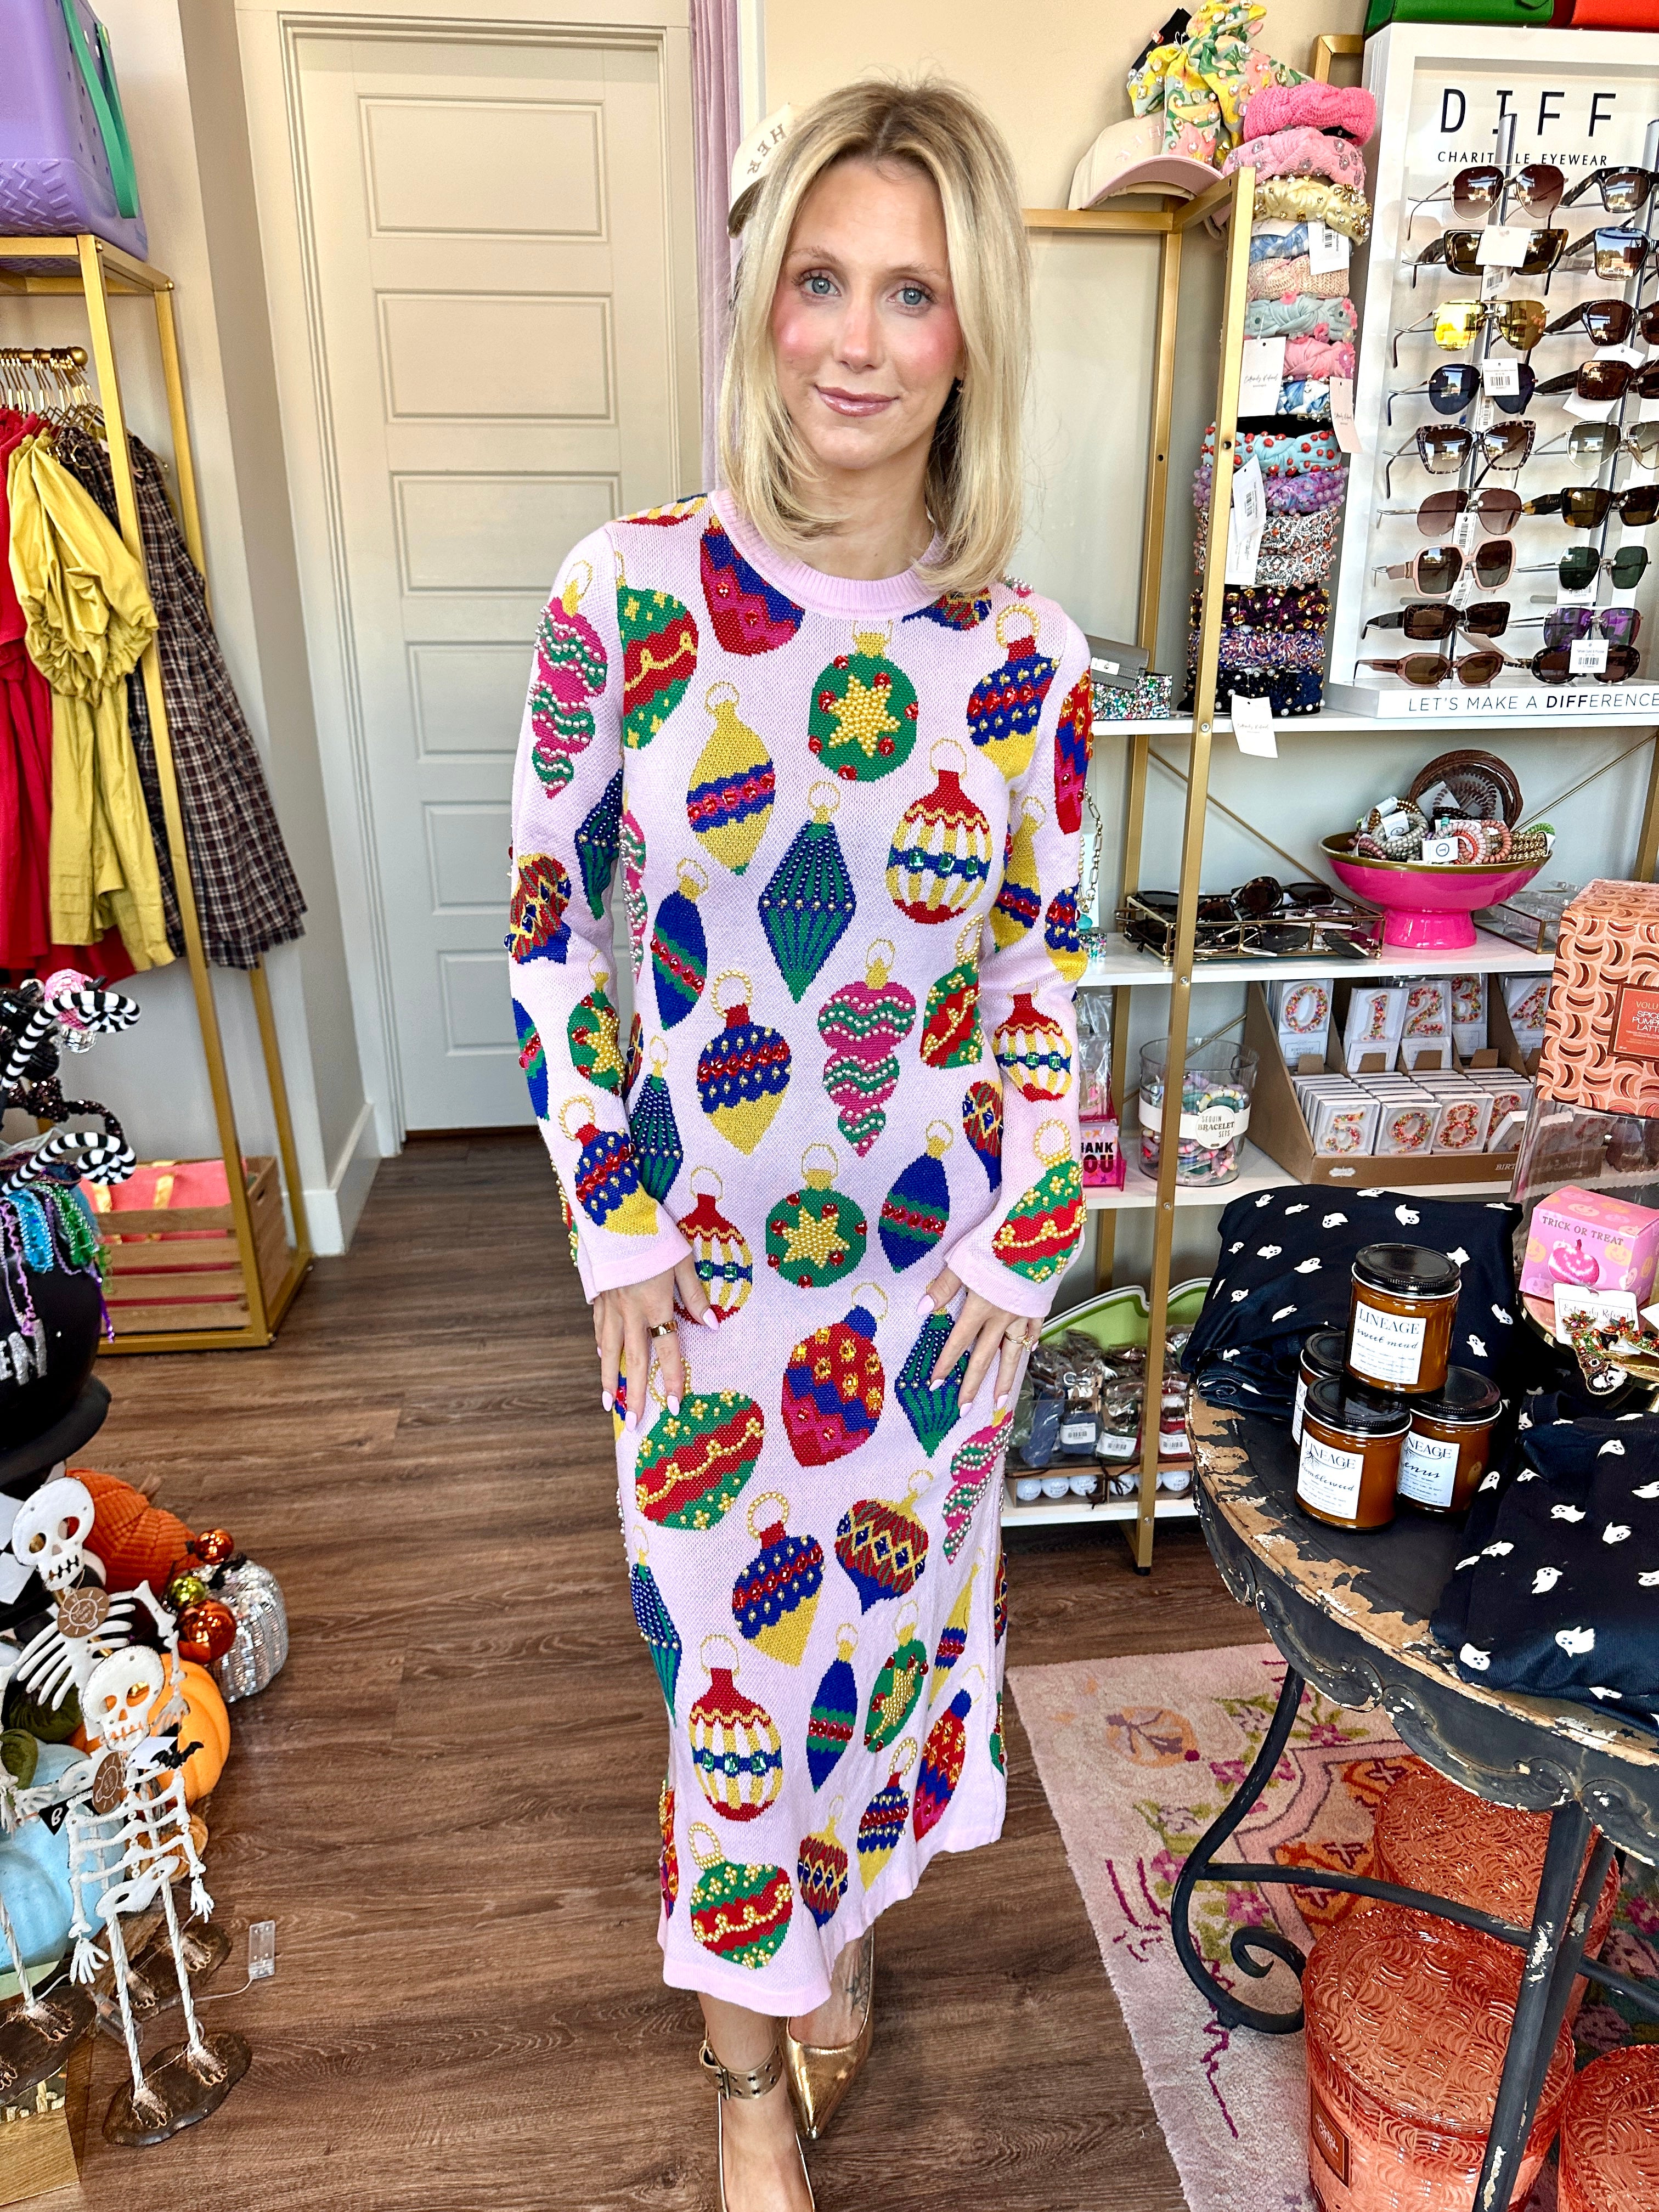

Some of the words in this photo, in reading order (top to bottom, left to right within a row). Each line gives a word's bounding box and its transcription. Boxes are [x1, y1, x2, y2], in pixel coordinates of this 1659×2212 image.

[1441, 88, 1616, 137] DIFF
[1438, 151, 1530, 164] CHARITLE
[1542, 154, 1607, 166] EYEWEAR
[1409, 697, 1458, 712] LET'S
[1467, 696, 1518, 709] MAKE
[1526, 696, 1537, 708] A
[1547, 692, 1659, 708] DIFFERENCE
[1636, 1001, 1659, 1010] VOLU
[1198, 1121, 1234, 1132] BRACELET
[1083, 1154, 1114, 1173] OU
[1543, 1216, 1571, 1232] TRICK
[1573, 1226, 1587, 1235] OR
[1591, 1230, 1624, 1246] TREAT
[1358, 1308, 1420, 1334] LINEAGE
[1357, 1328, 1385, 1342] sweet
[1408, 1437, 1452, 1459] NEAGE
[1404, 1462, 1440, 1478] enus
